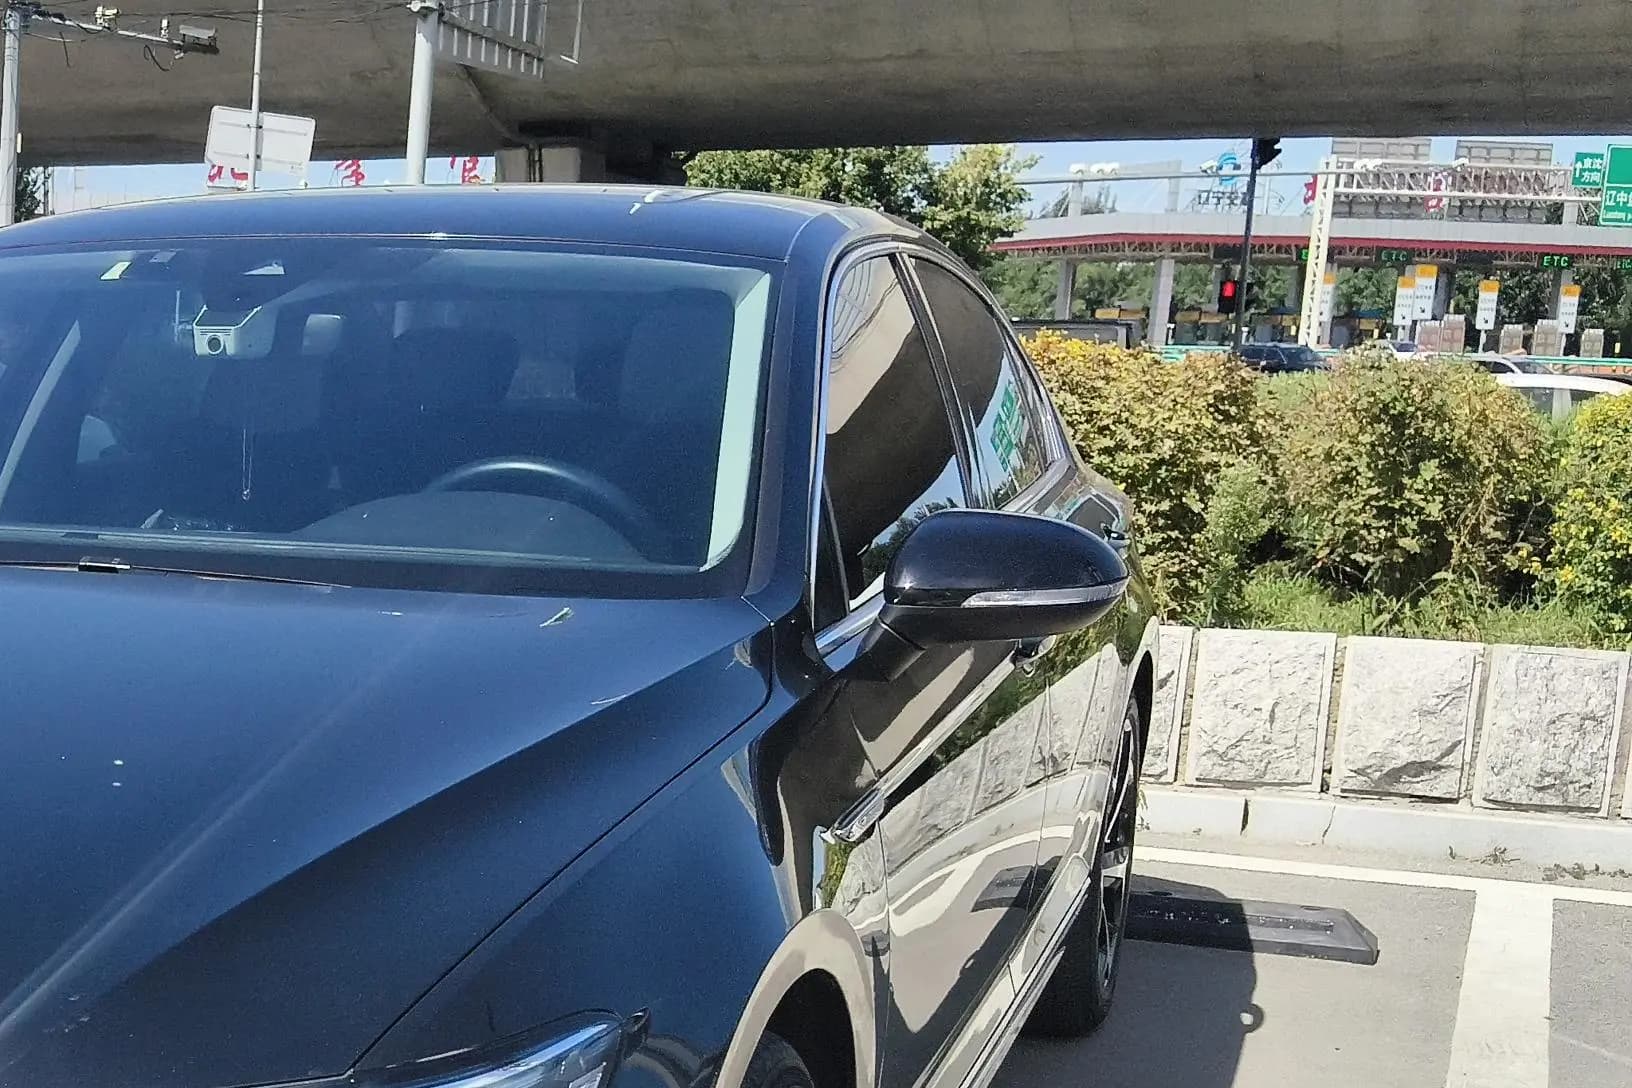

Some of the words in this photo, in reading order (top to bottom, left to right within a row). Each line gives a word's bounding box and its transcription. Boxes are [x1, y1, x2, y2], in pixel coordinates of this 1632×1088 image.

[1581, 171, 1601, 183] 方向
[1381, 250, 1408, 261] ETC
[1543, 255, 1569, 267] ETC
